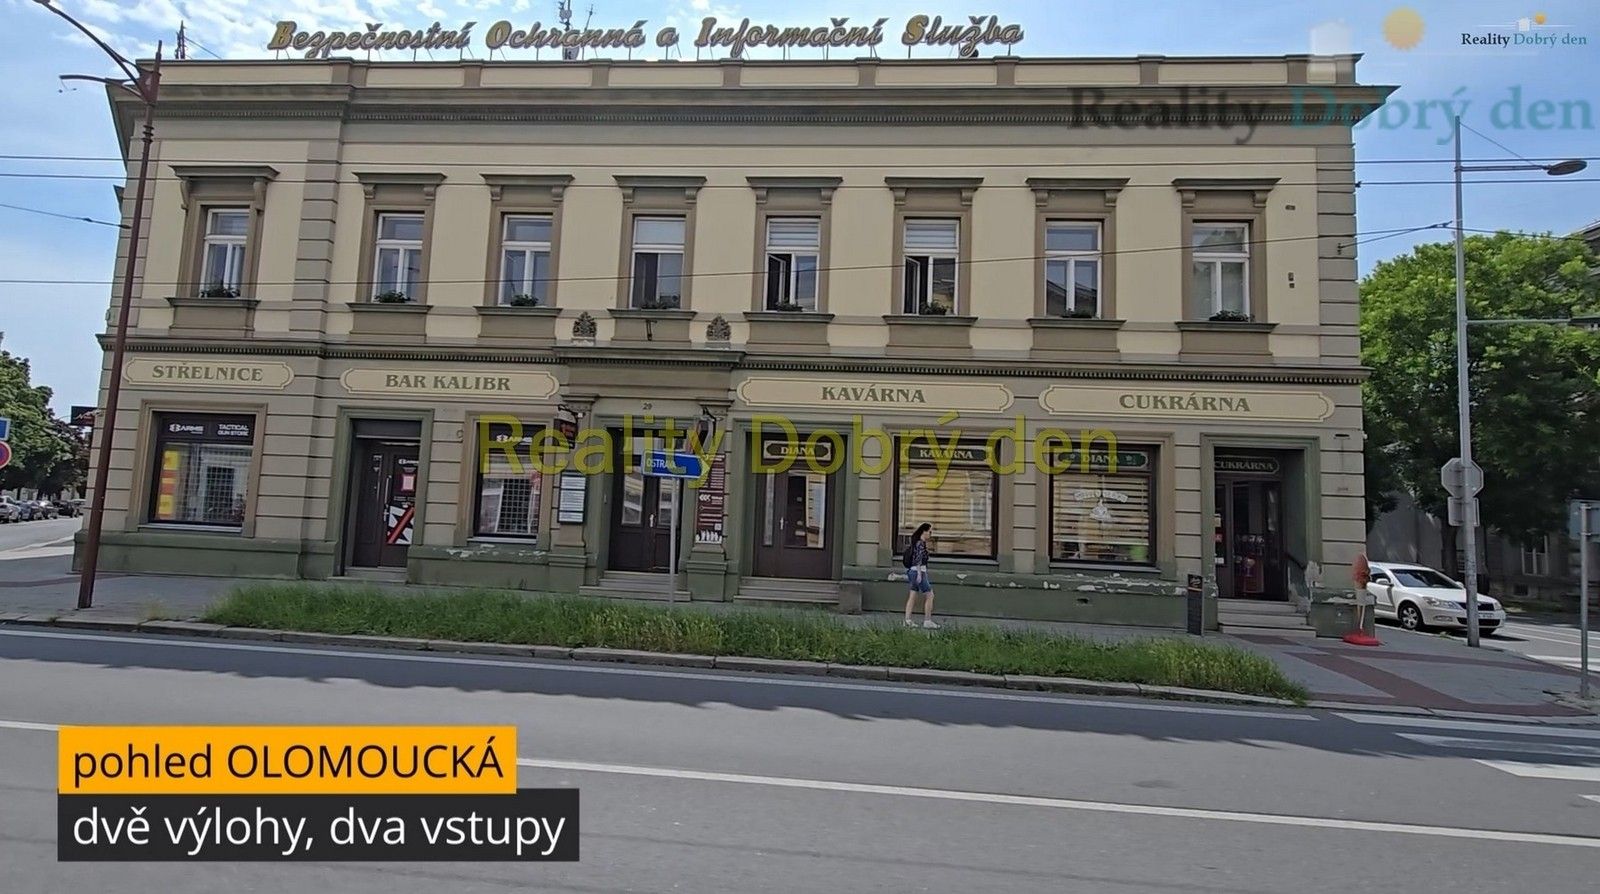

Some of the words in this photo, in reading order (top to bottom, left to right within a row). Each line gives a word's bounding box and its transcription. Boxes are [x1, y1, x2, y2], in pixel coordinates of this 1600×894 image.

[267, 20, 478, 59] Bezpečnostní
[485, 20, 647, 50] Ochranná
[656, 27, 680, 47] a
[694, 16, 889, 59] Informační
[901, 15, 1024, 58] Služba
[152, 361, 263, 382] STŘELNICE
[385, 374, 426, 389] BAR
[433, 375, 511, 391] KALIBR
[820, 384, 926, 403] KAVÁRNA
[1119, 392, 1250, 412] CUKRÁRNA
[780, 446, 815, 455] DIANA
[1083, 454, 1120, 463] DIANA
